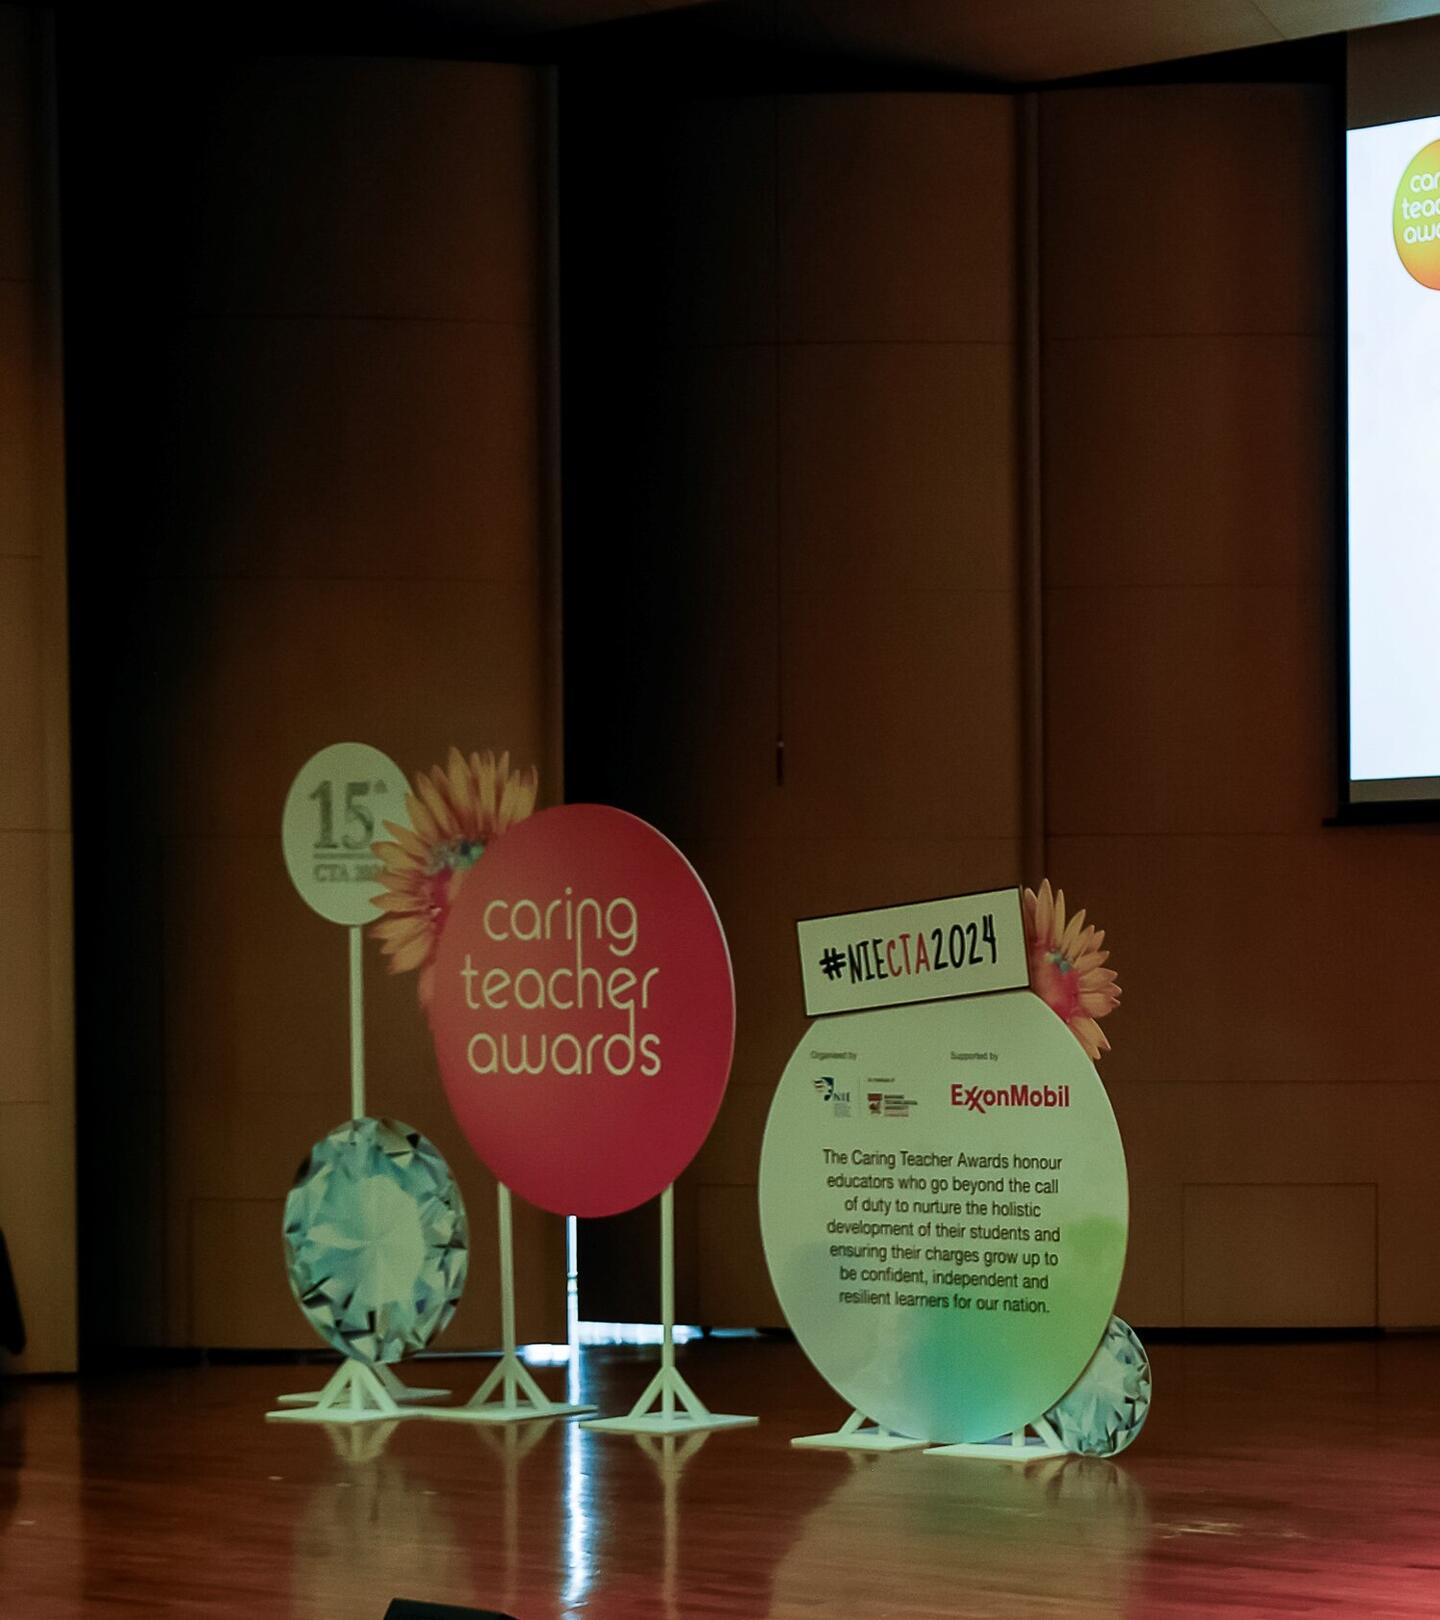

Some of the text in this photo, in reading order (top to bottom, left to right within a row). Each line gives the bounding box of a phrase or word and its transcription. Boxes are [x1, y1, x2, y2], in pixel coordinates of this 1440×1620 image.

[484, 887, 638, 956] caring
[819, 914, 997, 984] #NIECTA2024
[460, 954, 659, 1010] teacher
[467, 1010, 661, 1076] awards
[951, 1084, 1069, 1113] ExxonMobil
[823, 1149, 1063, 1170] The Caring Teacher Awards honour
[827, 1174, 1059, 1195] educators who go beyond the call
[844, 1196, 1042, 1217] of duty to nurture the holistic
[827, 1219, 1061, 1242] development of their students and
[830, 1243, 1059, 1268] ensuring their charges grow up to
[840, 1266, 1049, 1289] be confident, independent and
[839, 1289, 1051, 1313] resilient learners for our nation.
